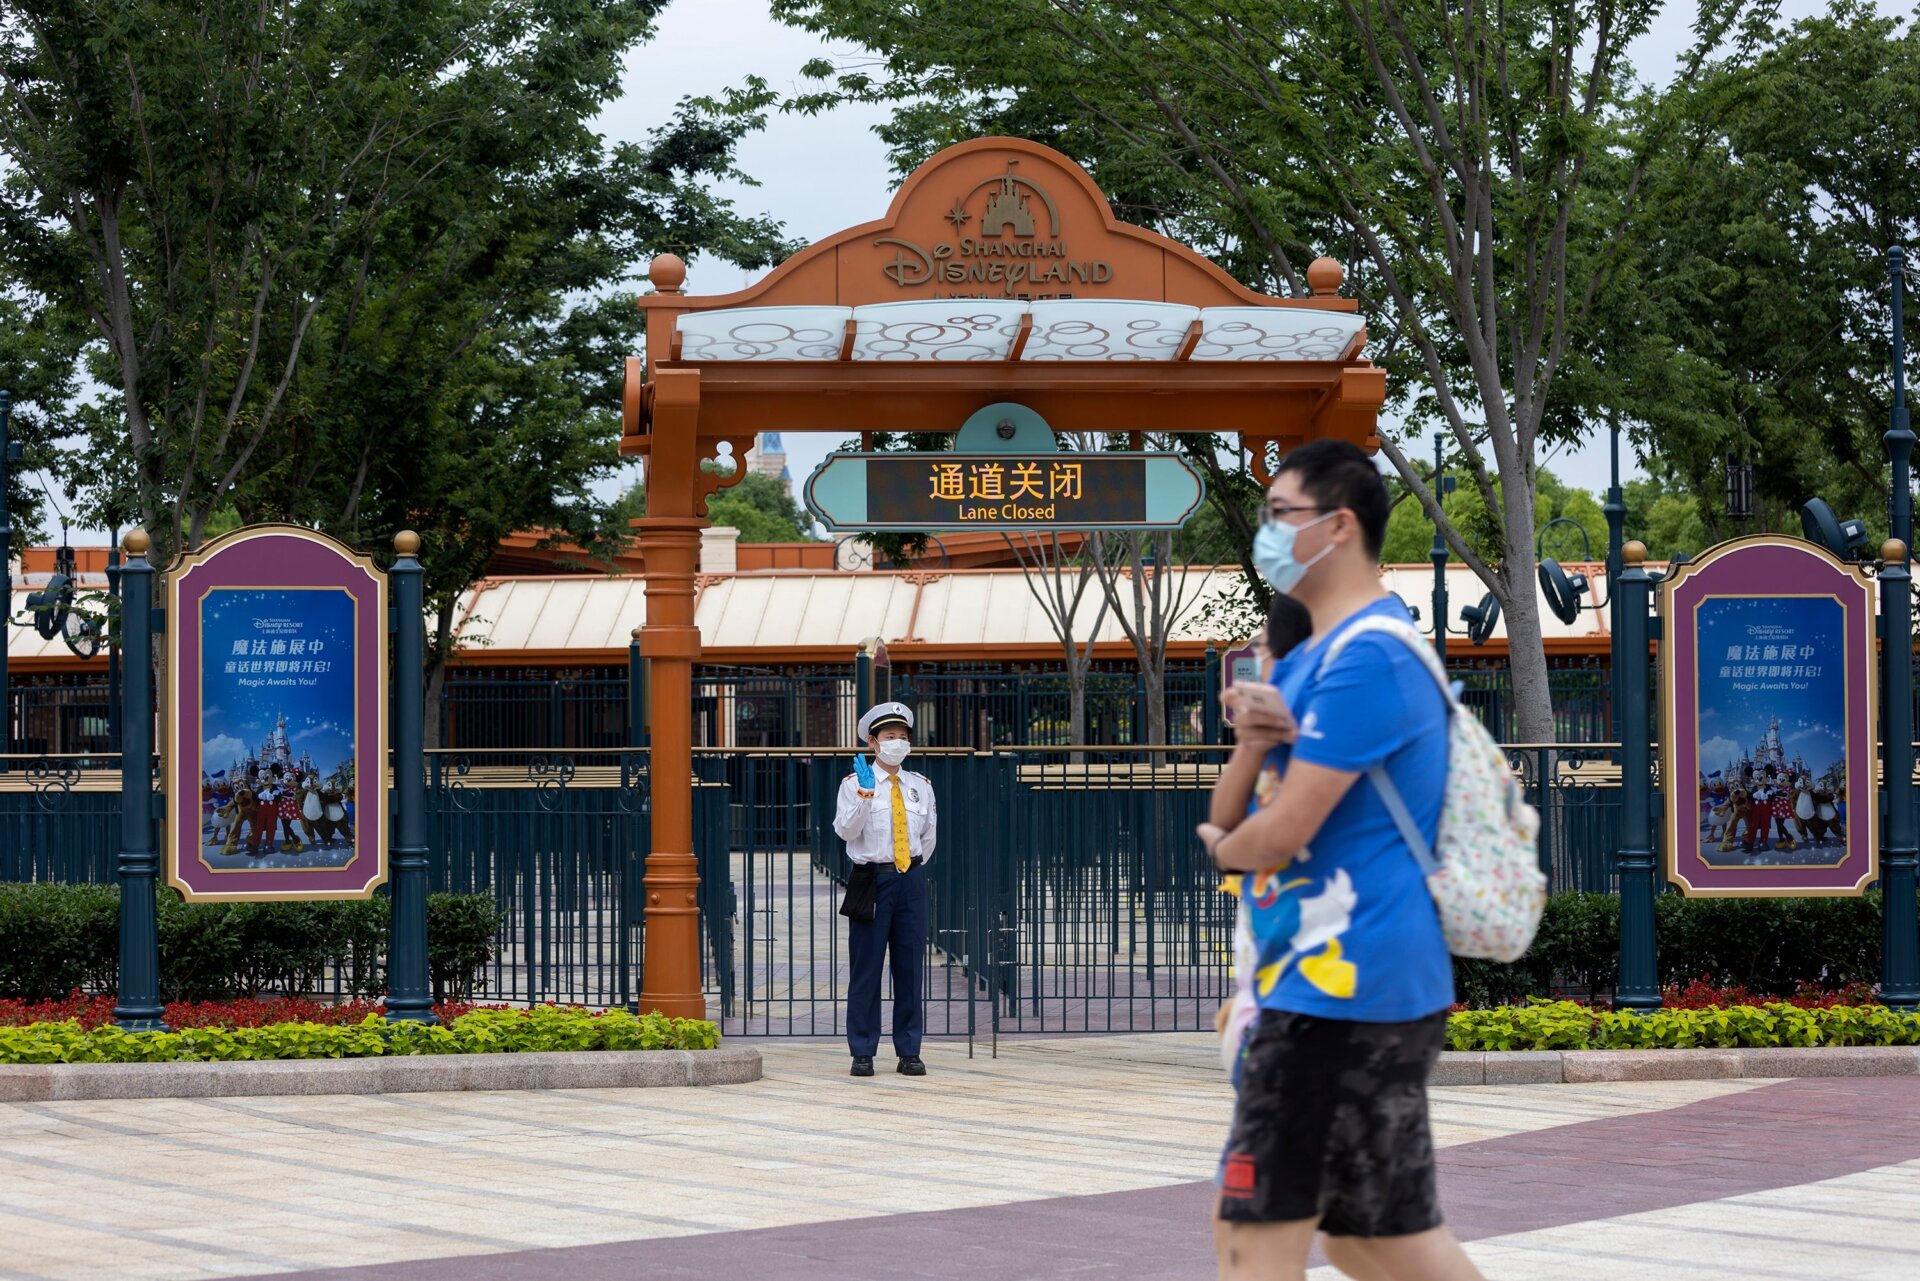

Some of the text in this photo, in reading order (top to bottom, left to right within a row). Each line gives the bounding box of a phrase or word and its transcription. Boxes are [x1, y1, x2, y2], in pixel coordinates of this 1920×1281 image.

[960, 238, 1066, 257] SHANGHAI
[929, 462, 1082, 500] 通道关闭
[959, 503, 1055, 520] Lane Closed
[232, 639, 324, 655] 魔法施展中
[1726, 645, 1815, 660] 魔法施展中
[238, 678, 317, 688] Magic Awaits You!
[1732, 682, 1809, 692] Magic Awaits You!
